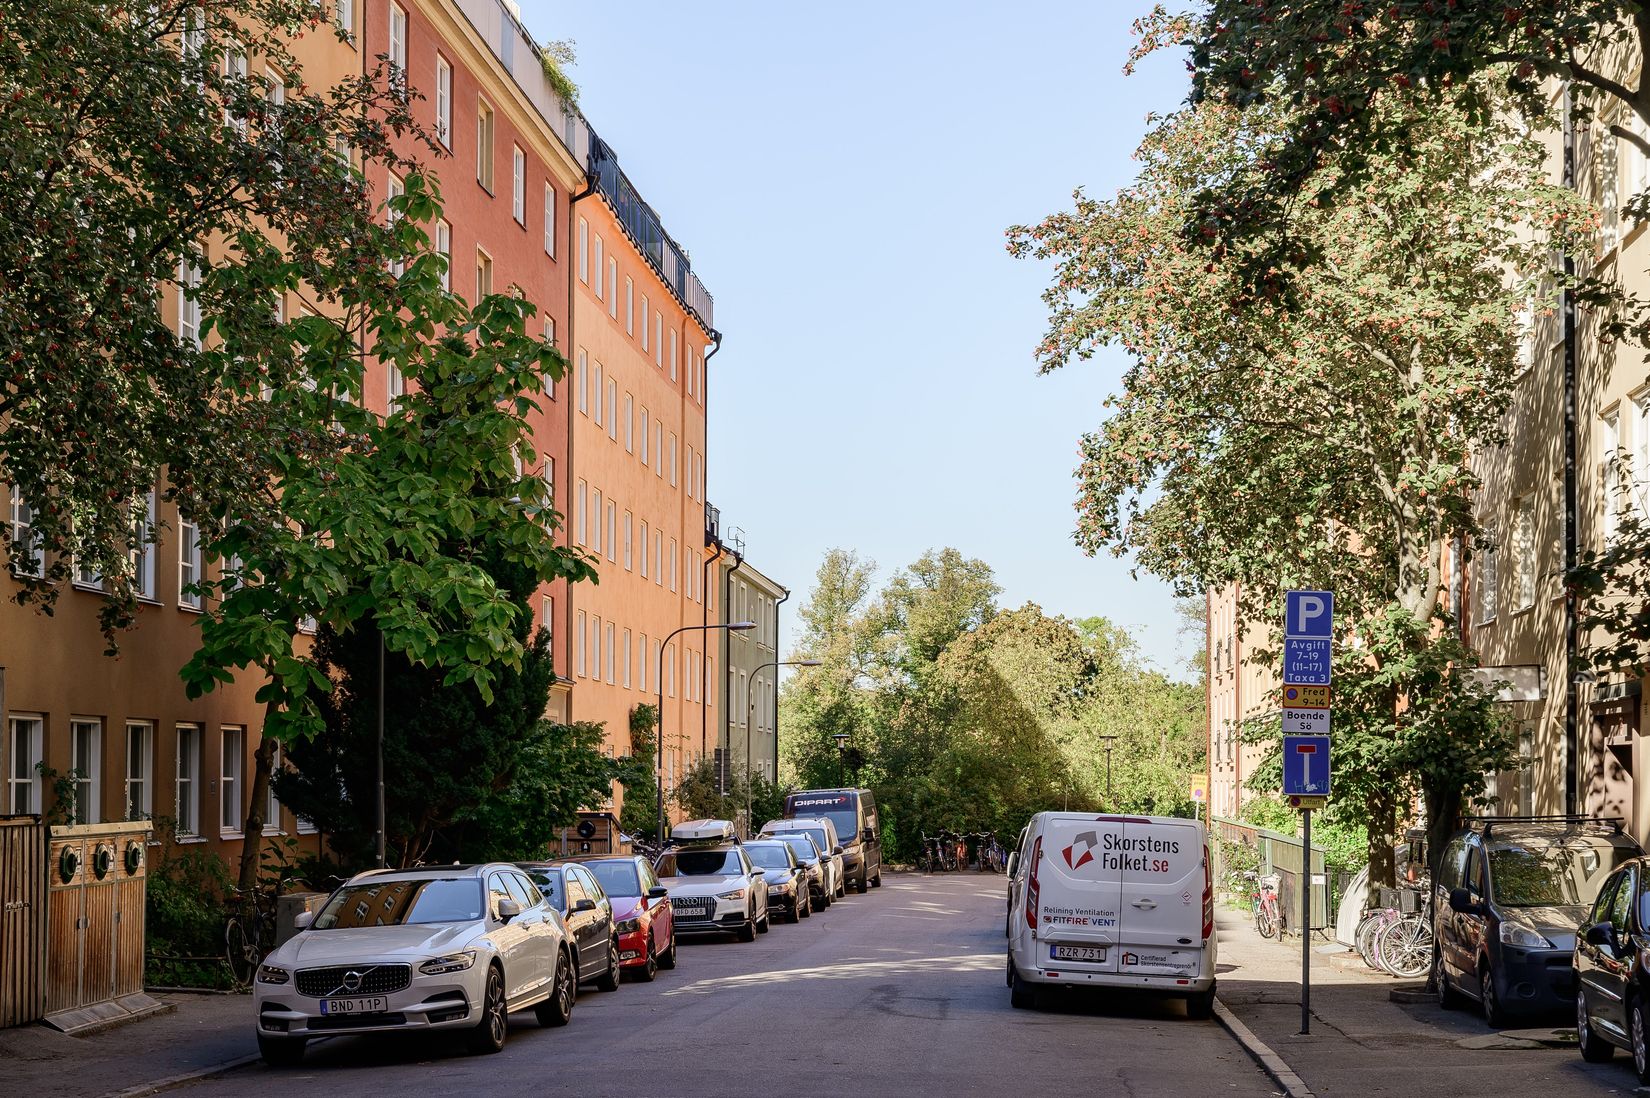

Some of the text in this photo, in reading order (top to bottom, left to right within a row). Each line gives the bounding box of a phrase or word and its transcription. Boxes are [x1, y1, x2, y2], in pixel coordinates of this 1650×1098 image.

[1299, 596, 1324, 632] P
[1291, 641, 1325, 650] Avgift
[1289, 674, 1315, 682] Taxa
[1303, 688, 1325, 696] Fred
[1287, 711, 1324, 720] Boende
[1300, 722, 1312, 730] Sö
[794, 798, 840, 806] DIPART
[1104, 834, 1179, 854] Skorstens
[1102, 853, 1168, 872] Folket.se
[1044, 906, 1114, 916] Relining Ventilation
[1060, 948, 1101, 958] RZR 731
[331, 999, 380, 1012] BND 11P
